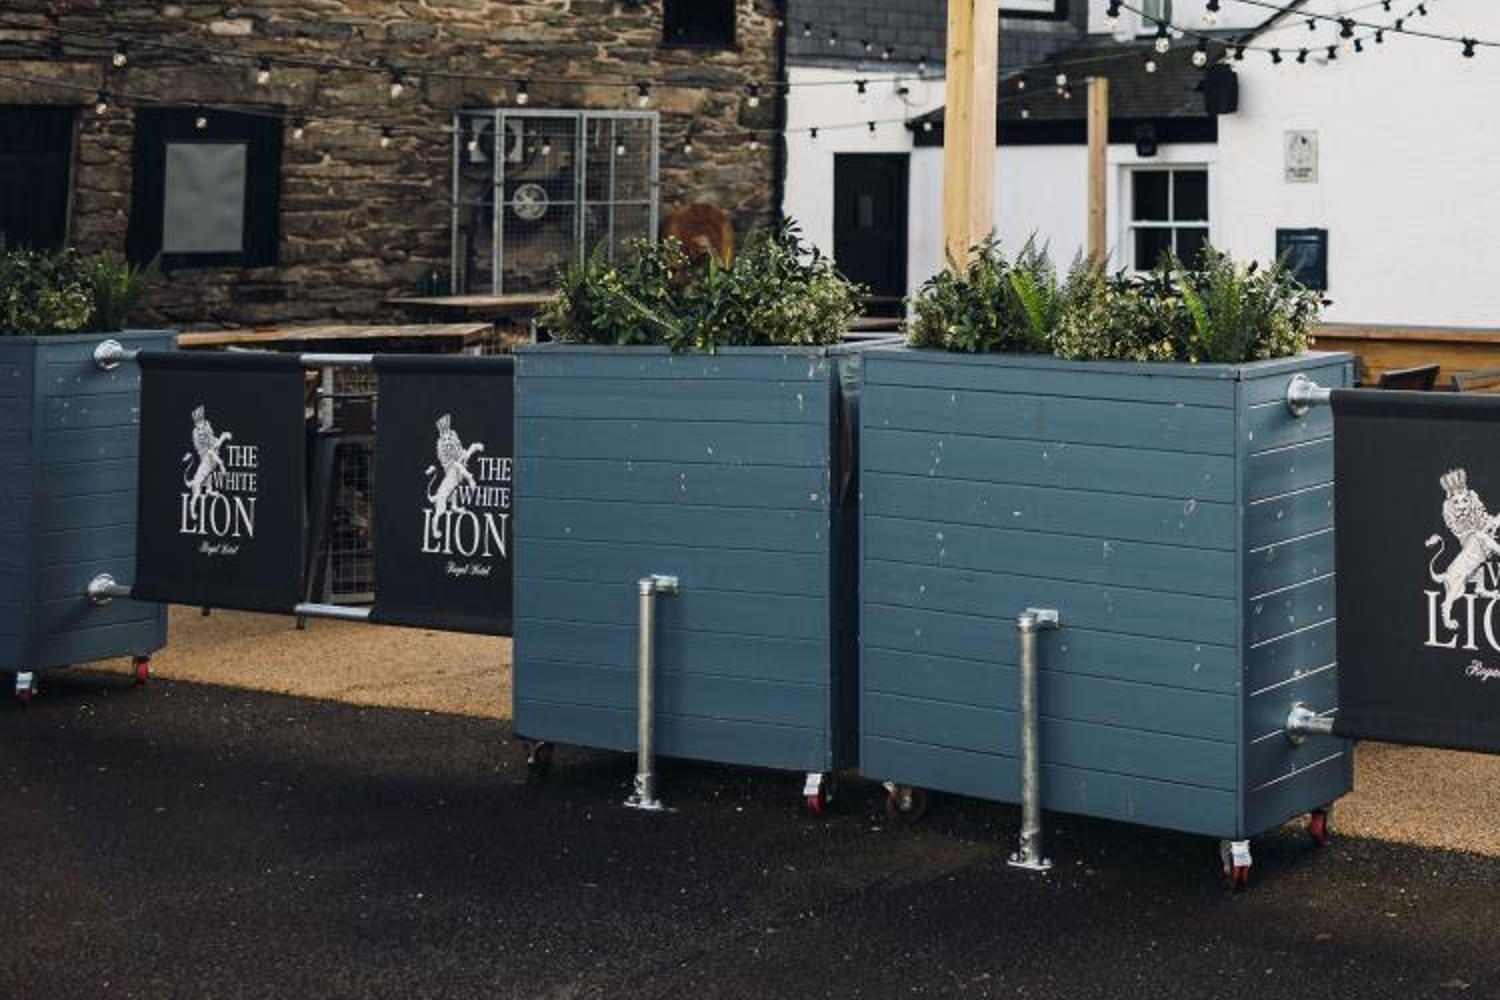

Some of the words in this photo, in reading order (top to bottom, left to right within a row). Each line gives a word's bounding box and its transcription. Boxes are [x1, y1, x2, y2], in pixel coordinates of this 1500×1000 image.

[227, 445, 257, 469] THE
[477, 457, 512, 482] THE
[212, 472, 257, 493] WHITE
[456, 486, 511, 508] WHITE
[179, 493, 256, 537] LION
[420, 509, 510, 559] LION
